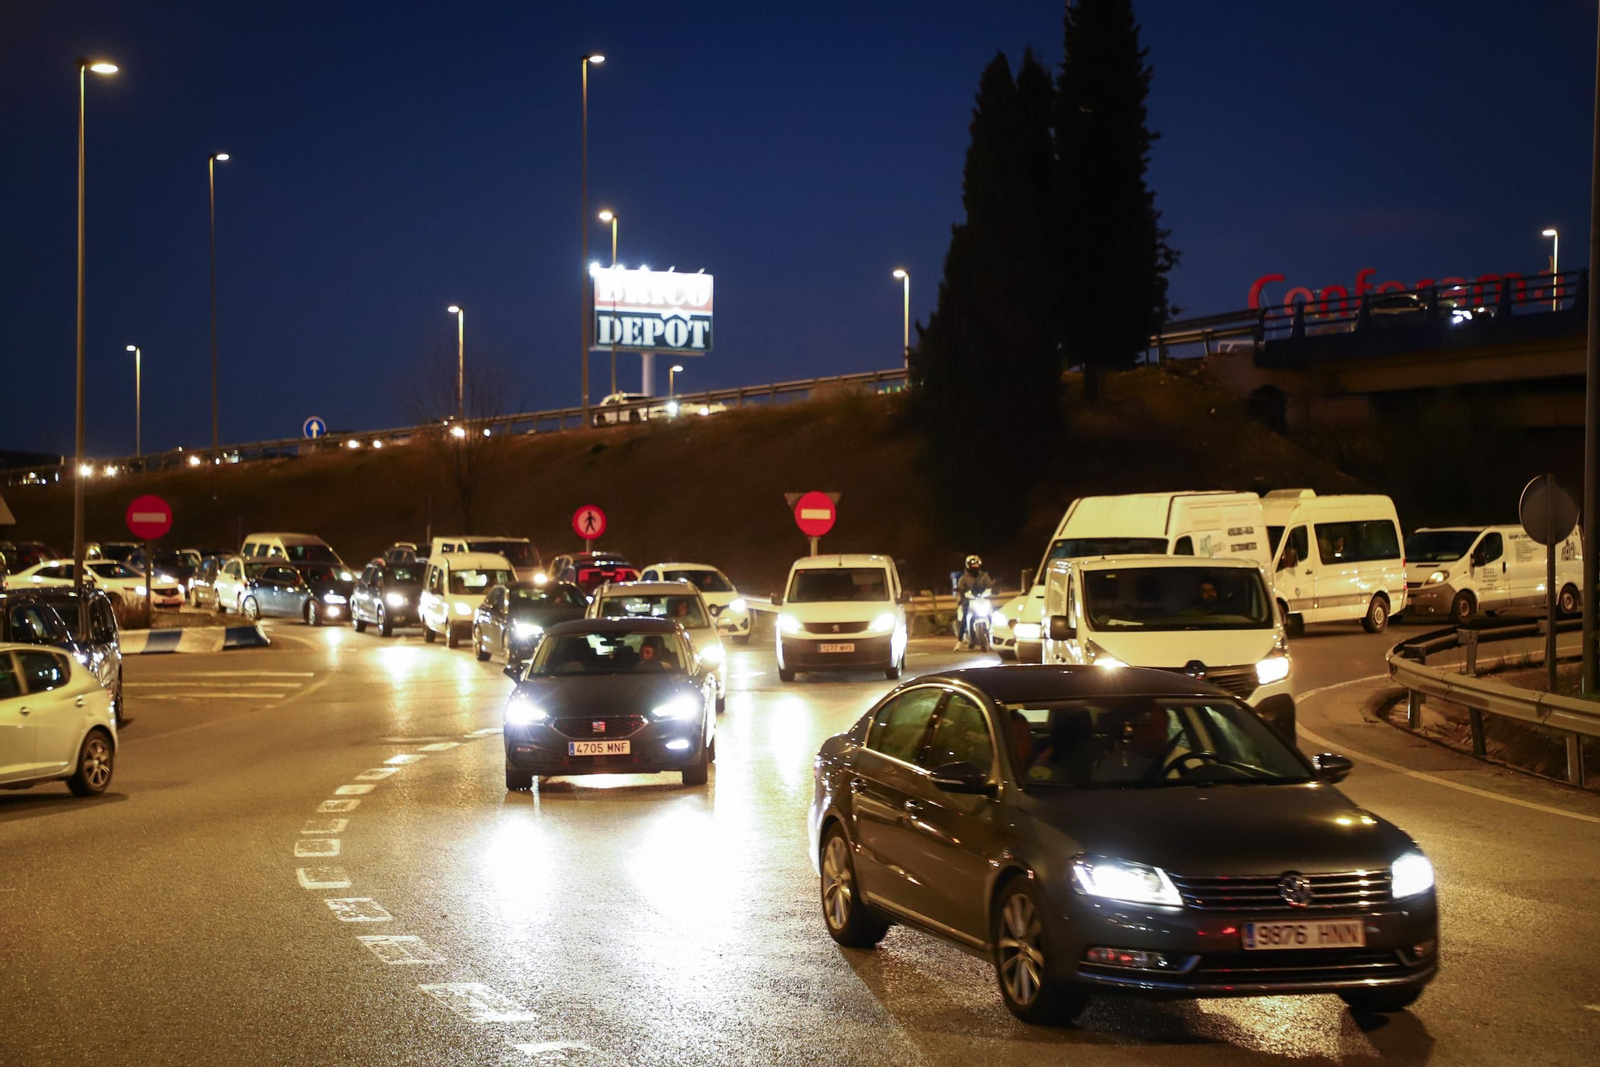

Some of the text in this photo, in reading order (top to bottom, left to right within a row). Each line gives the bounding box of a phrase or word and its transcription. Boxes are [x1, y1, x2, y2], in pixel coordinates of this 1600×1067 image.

[598, 315, 710, 349] DEPOT
[576, 742, 627, 754] 4705 MNF
[1257, 923, 1360, 946] 9876 HNN
